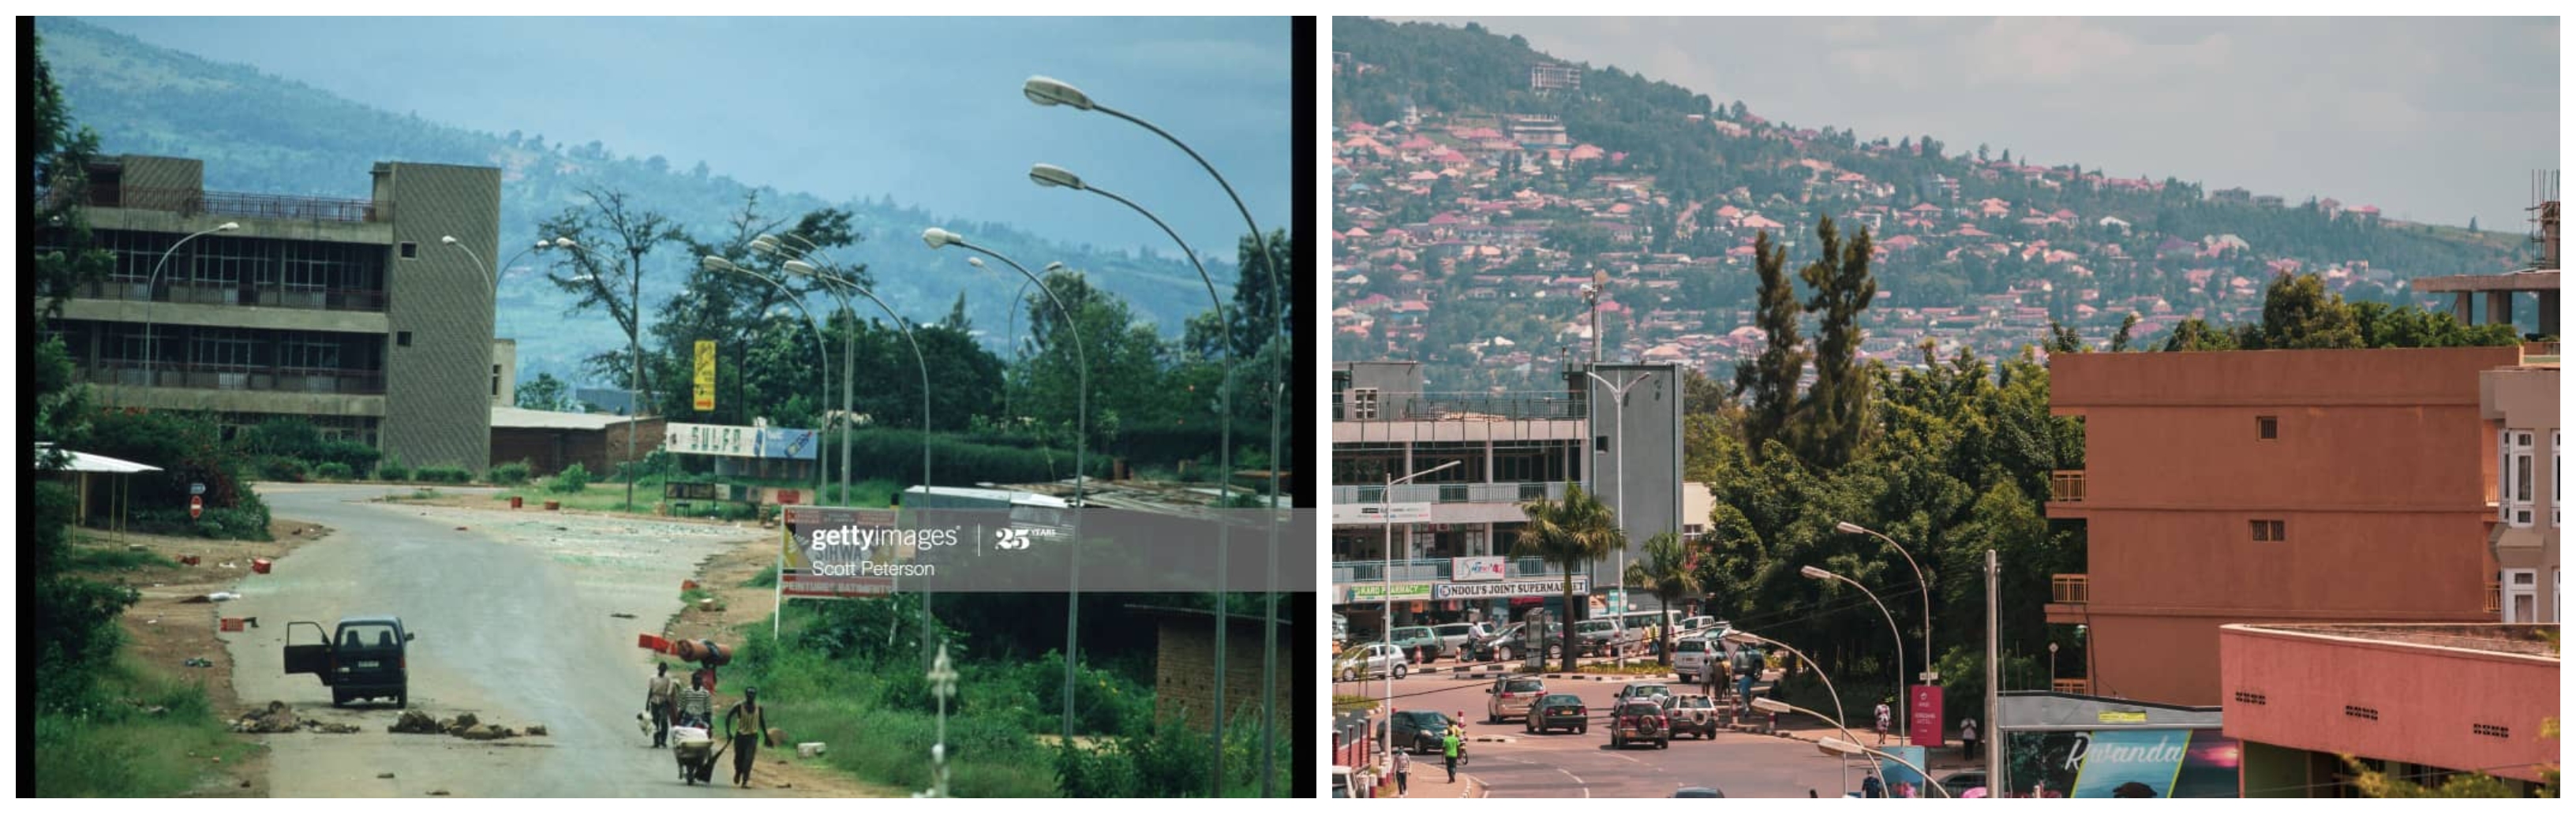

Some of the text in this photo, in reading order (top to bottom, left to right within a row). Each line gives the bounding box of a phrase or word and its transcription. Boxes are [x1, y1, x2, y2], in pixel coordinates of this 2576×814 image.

[1451, 586, 1487, 596] NDOLI'S
[1488, 584, 1515, 595] JOINT
[2065, 732, 2183, 770] Rwanda
